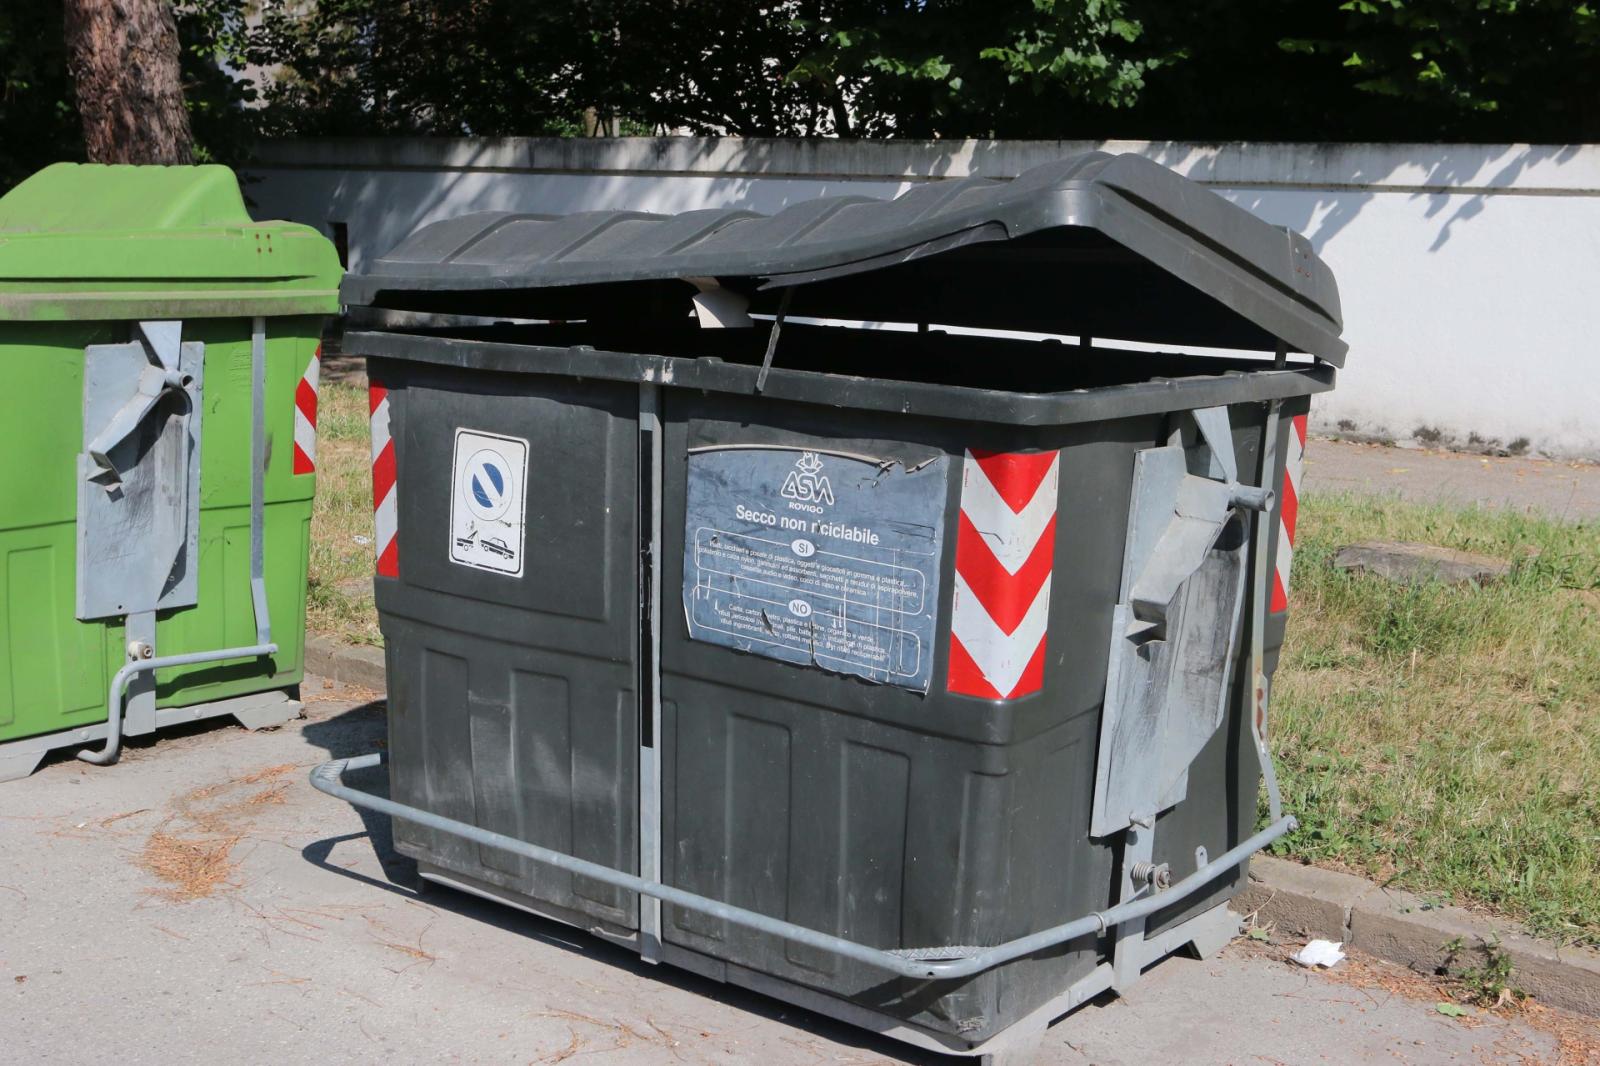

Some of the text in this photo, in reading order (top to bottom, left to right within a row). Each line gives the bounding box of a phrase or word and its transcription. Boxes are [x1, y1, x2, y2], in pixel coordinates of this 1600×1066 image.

[789, 502, 824, 514] ROVIGO
[736, 505, 776, 526] Secco
[781, 517, 806, 534] non
[798, 542, 810, 555] SI
[792, 602, 808, 615] NO
